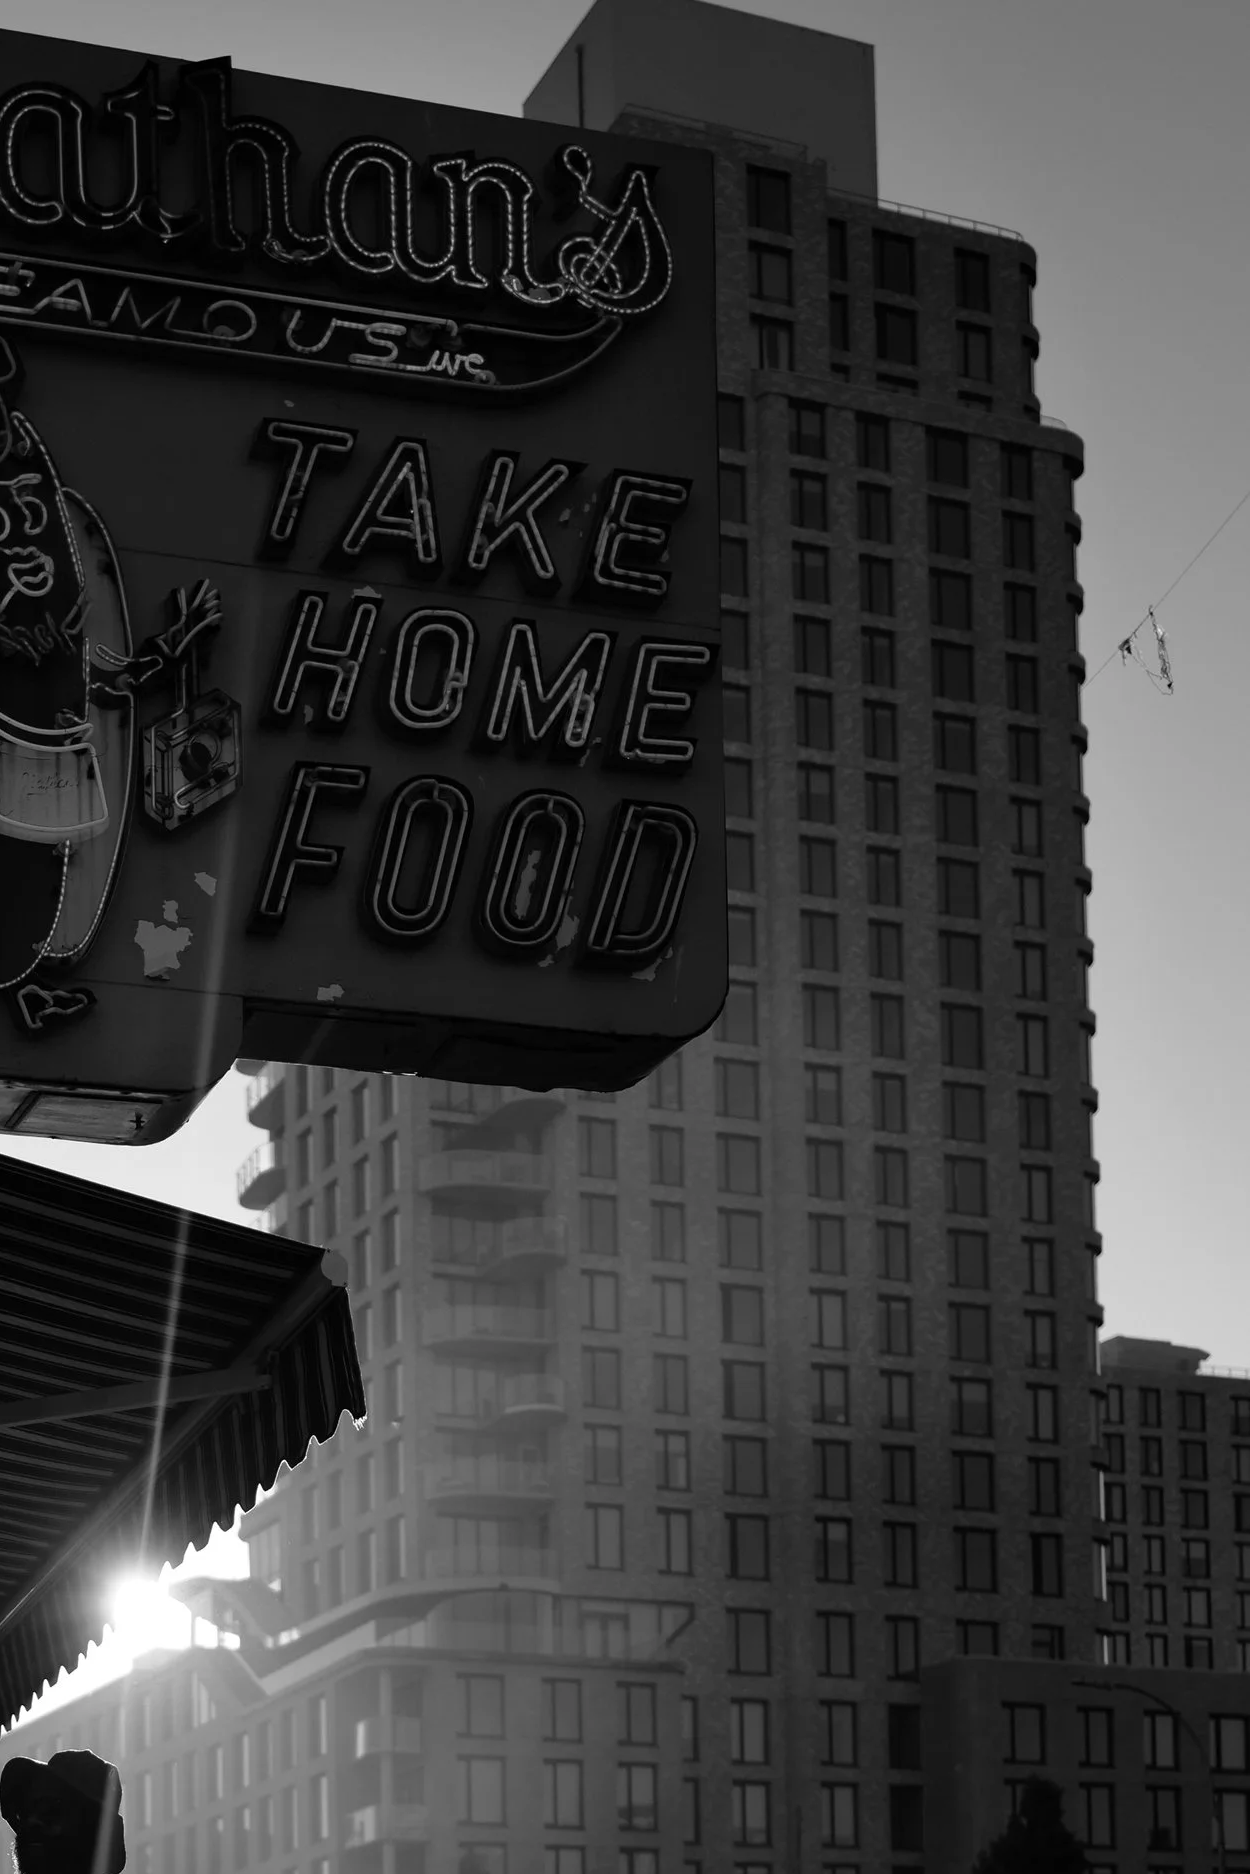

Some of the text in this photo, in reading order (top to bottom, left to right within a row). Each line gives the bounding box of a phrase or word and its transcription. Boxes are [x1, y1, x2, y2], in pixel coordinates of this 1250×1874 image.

[243, 417, 693, 608] TAKE
[258, 590, 720, 776] HOME
[247, 761, 700, 968] FOOD
